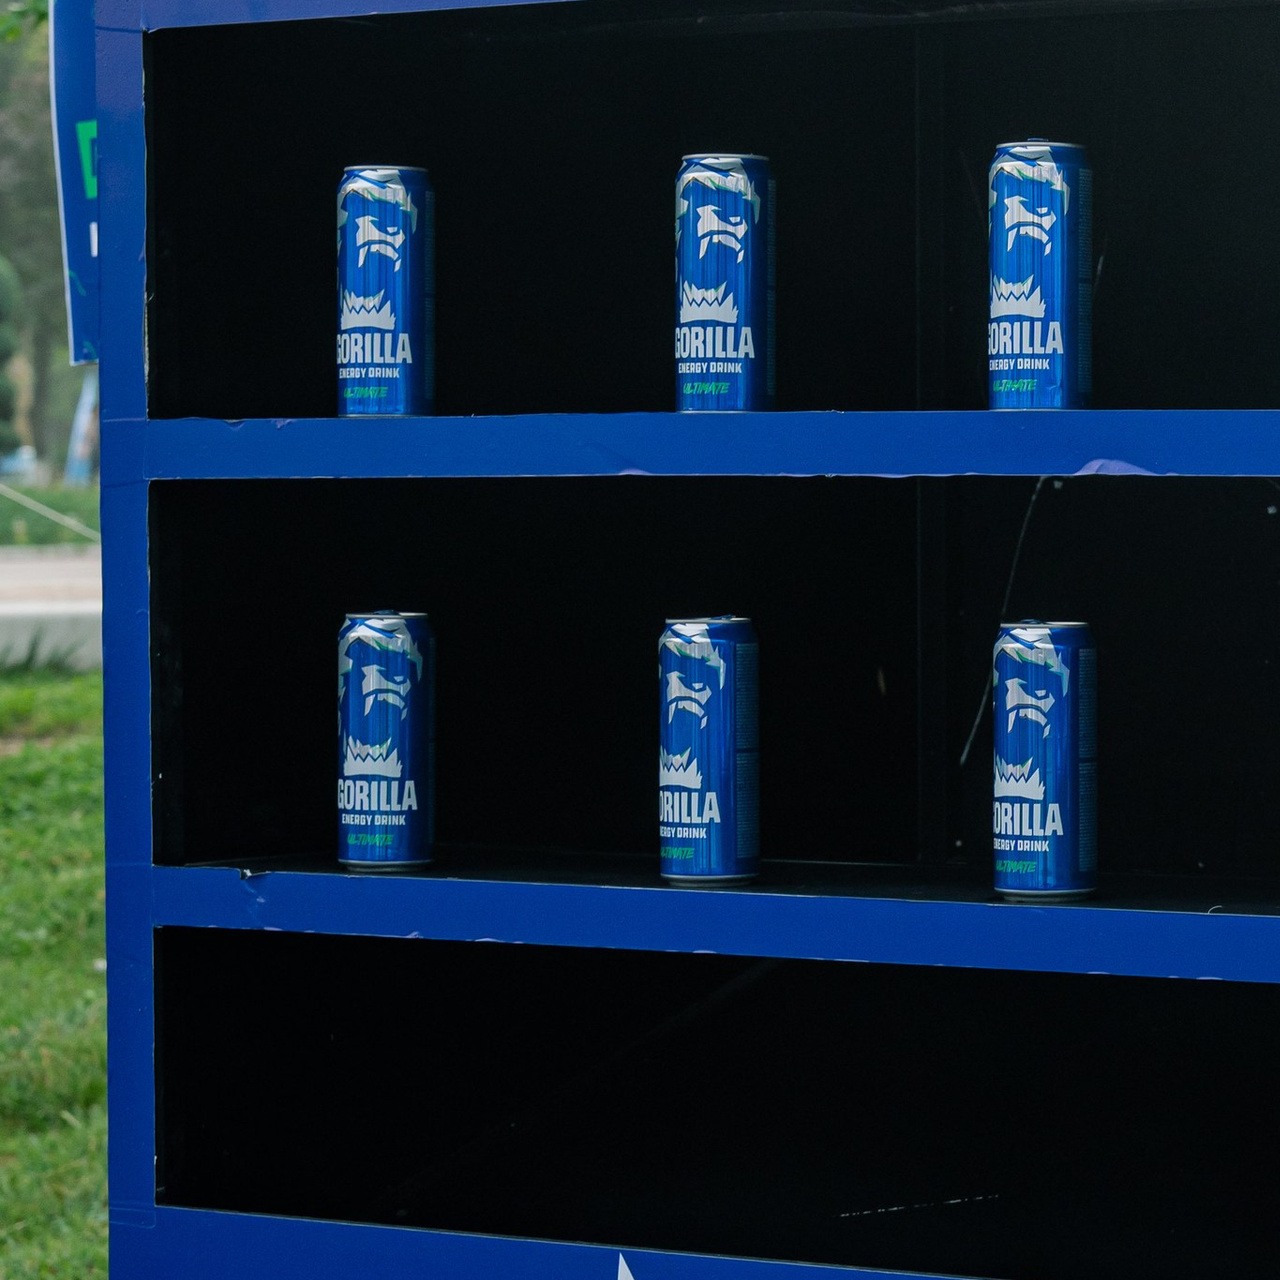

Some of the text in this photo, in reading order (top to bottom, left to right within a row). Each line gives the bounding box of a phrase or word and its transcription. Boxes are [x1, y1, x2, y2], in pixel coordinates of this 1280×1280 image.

[675, 326, 755, 358] GORILLA
[988, 321, 1063, 355] ORILLA
[678, 362, 742, 373] ENERGY DRINK
[1017, 358, 1050, 370] DRINK
[339, 367, 400, 378] ENERGY DRINK
[683, 382, 729, 395] ULTIMATE
[338, 779, 418, 811] GORILLA
[660, 790, 721, 823] ORILLA
[342, 813, 406, 826] ENERGY DRINK
[993, 802, 1064, 836] ORILLA
[676, 827, 707, 839] DRINK
[1017, 839, 1049, 852] DRINK
